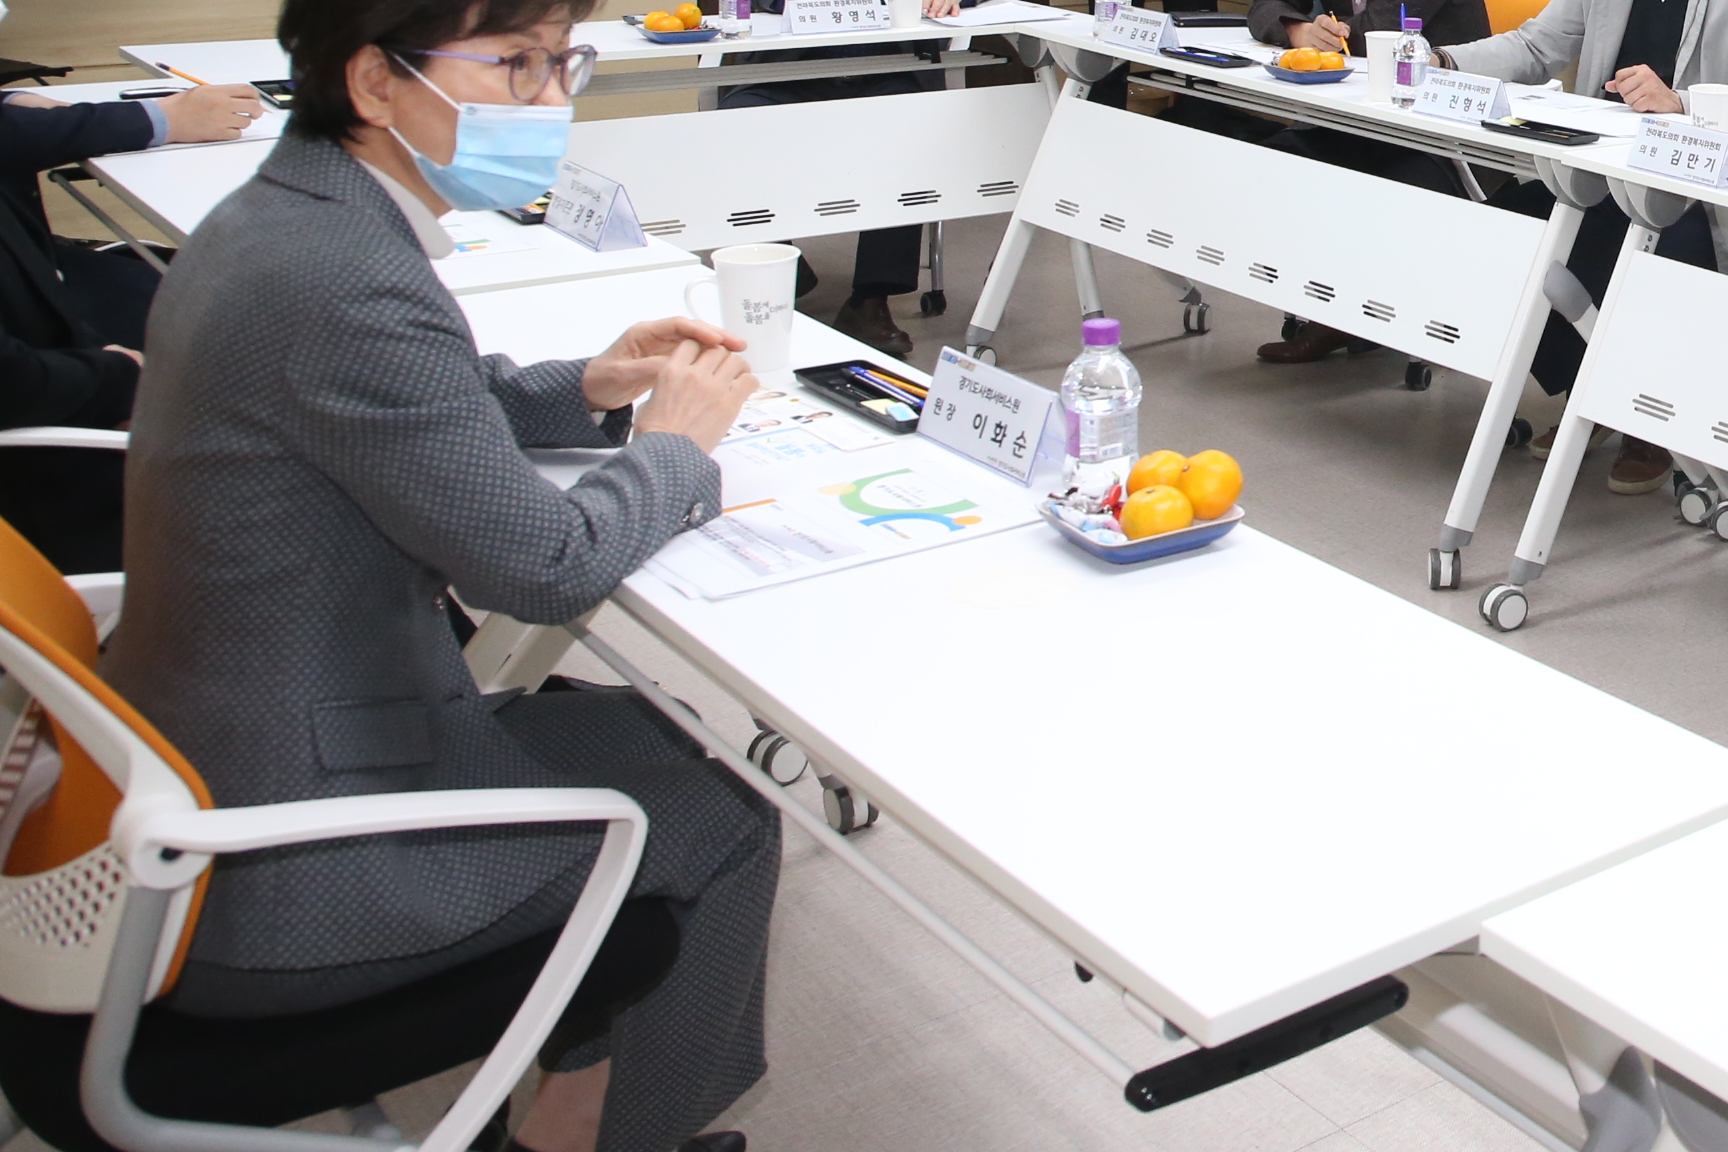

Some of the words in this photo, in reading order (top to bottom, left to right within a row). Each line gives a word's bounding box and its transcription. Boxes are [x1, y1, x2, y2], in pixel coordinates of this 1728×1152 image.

[797, 0, 832, 9] 전라북도의회
[1645, 127, 1680, 143] 전라북도의회
[1680, 136, 1721, 152] 환경복지위원회
[958, 375, 1021, 415] 경기도사회서비스원
